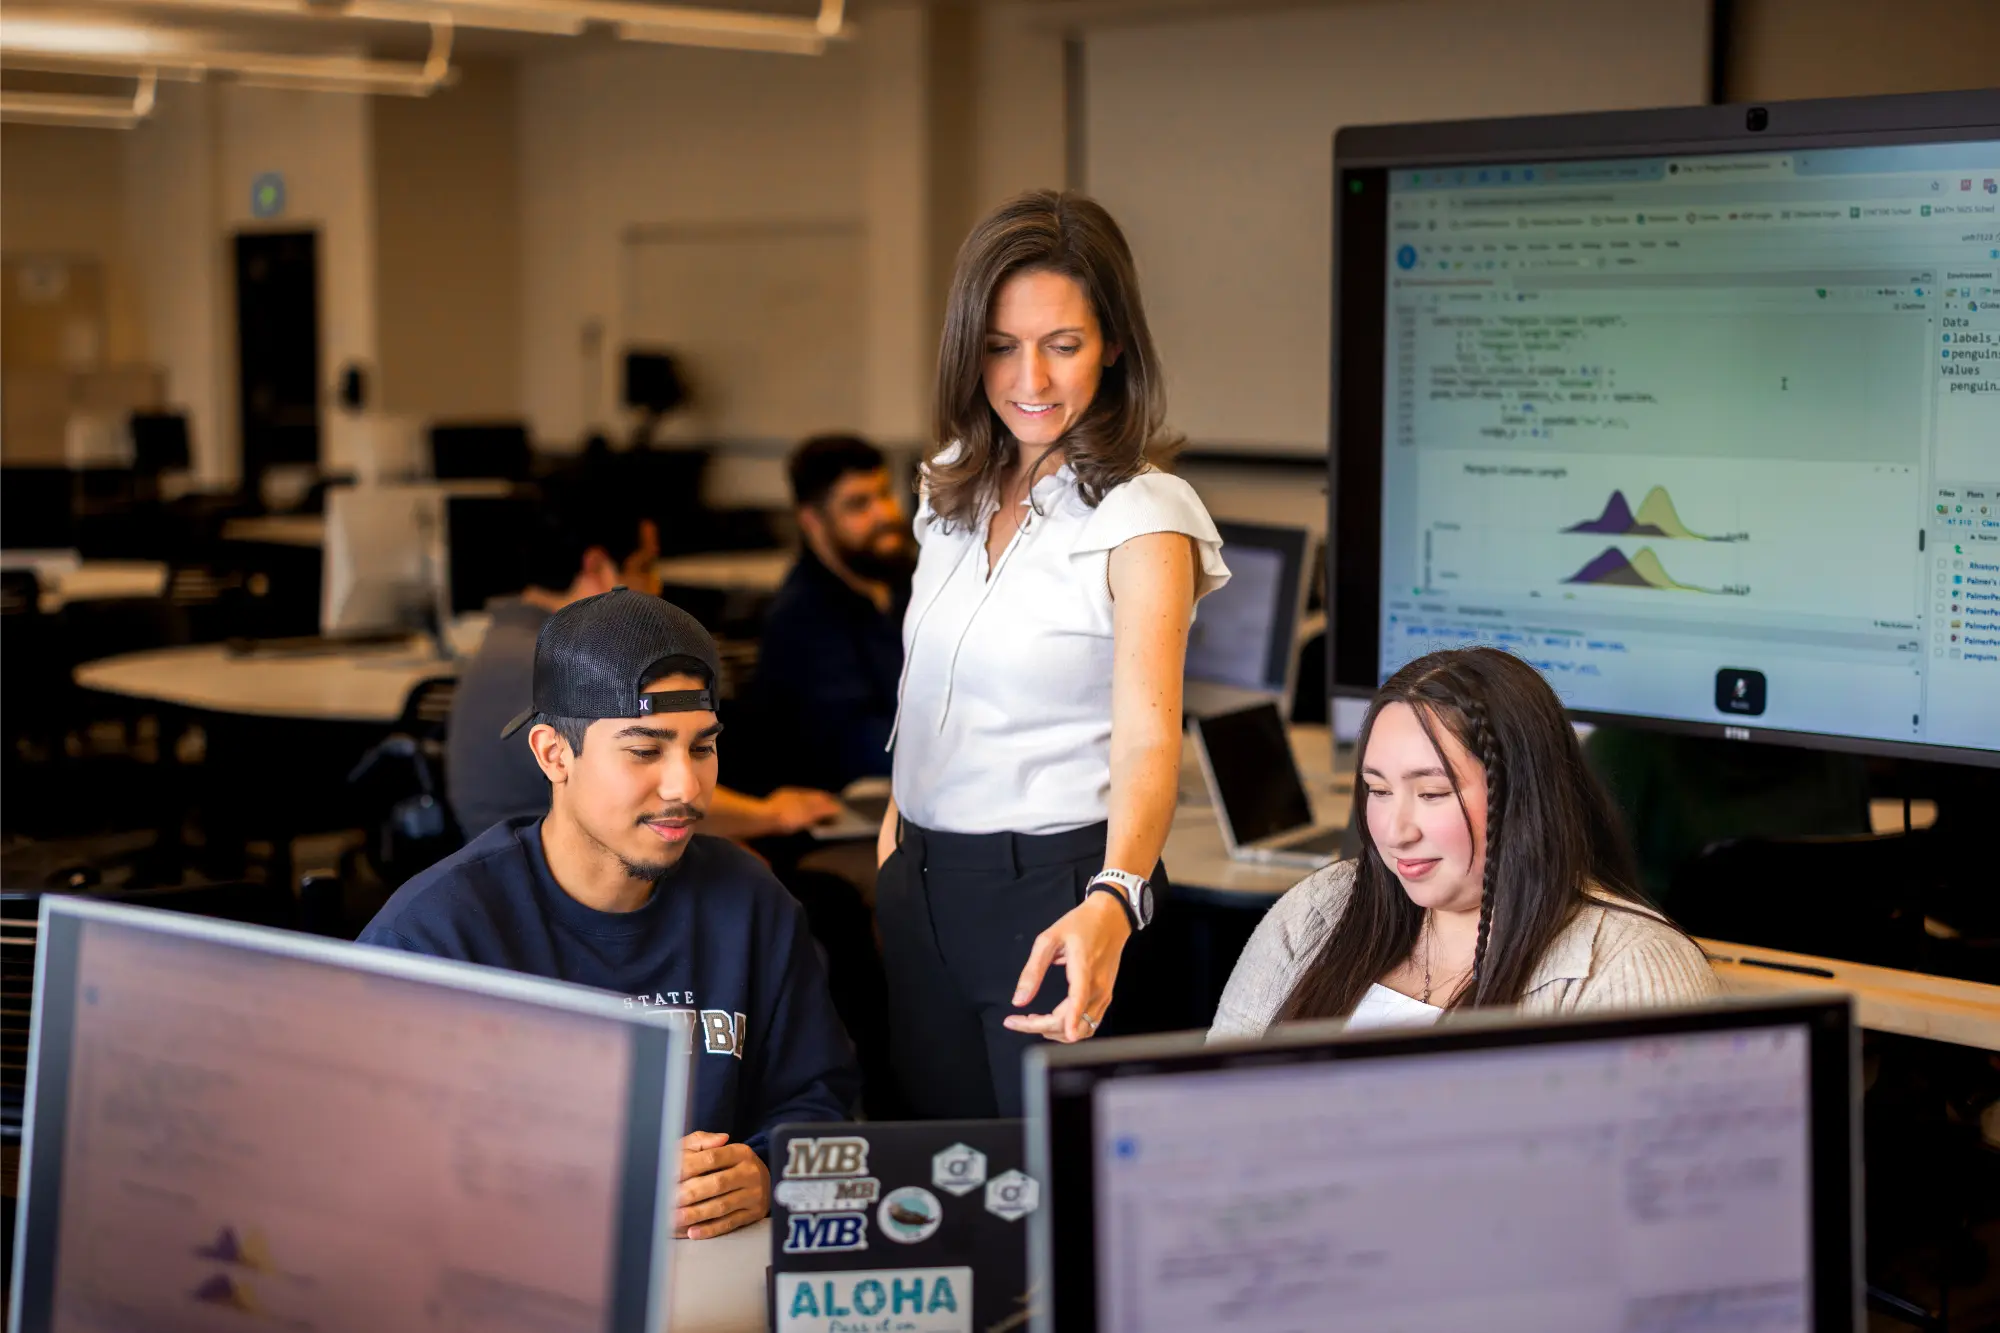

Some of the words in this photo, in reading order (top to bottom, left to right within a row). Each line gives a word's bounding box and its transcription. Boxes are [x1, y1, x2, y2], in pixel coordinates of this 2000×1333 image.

[1942, 316, 1970, 328] Data
[1952, 332, 2000, 346] labels_
[1941, 364, 1980, 375] Values
[623, 990, 695, 1009] STATE
[787, 1141, 864, 1175] MB
[787, 1218, 864, 1249] MB
[789, 1275, 958, 1318] ALOHA
